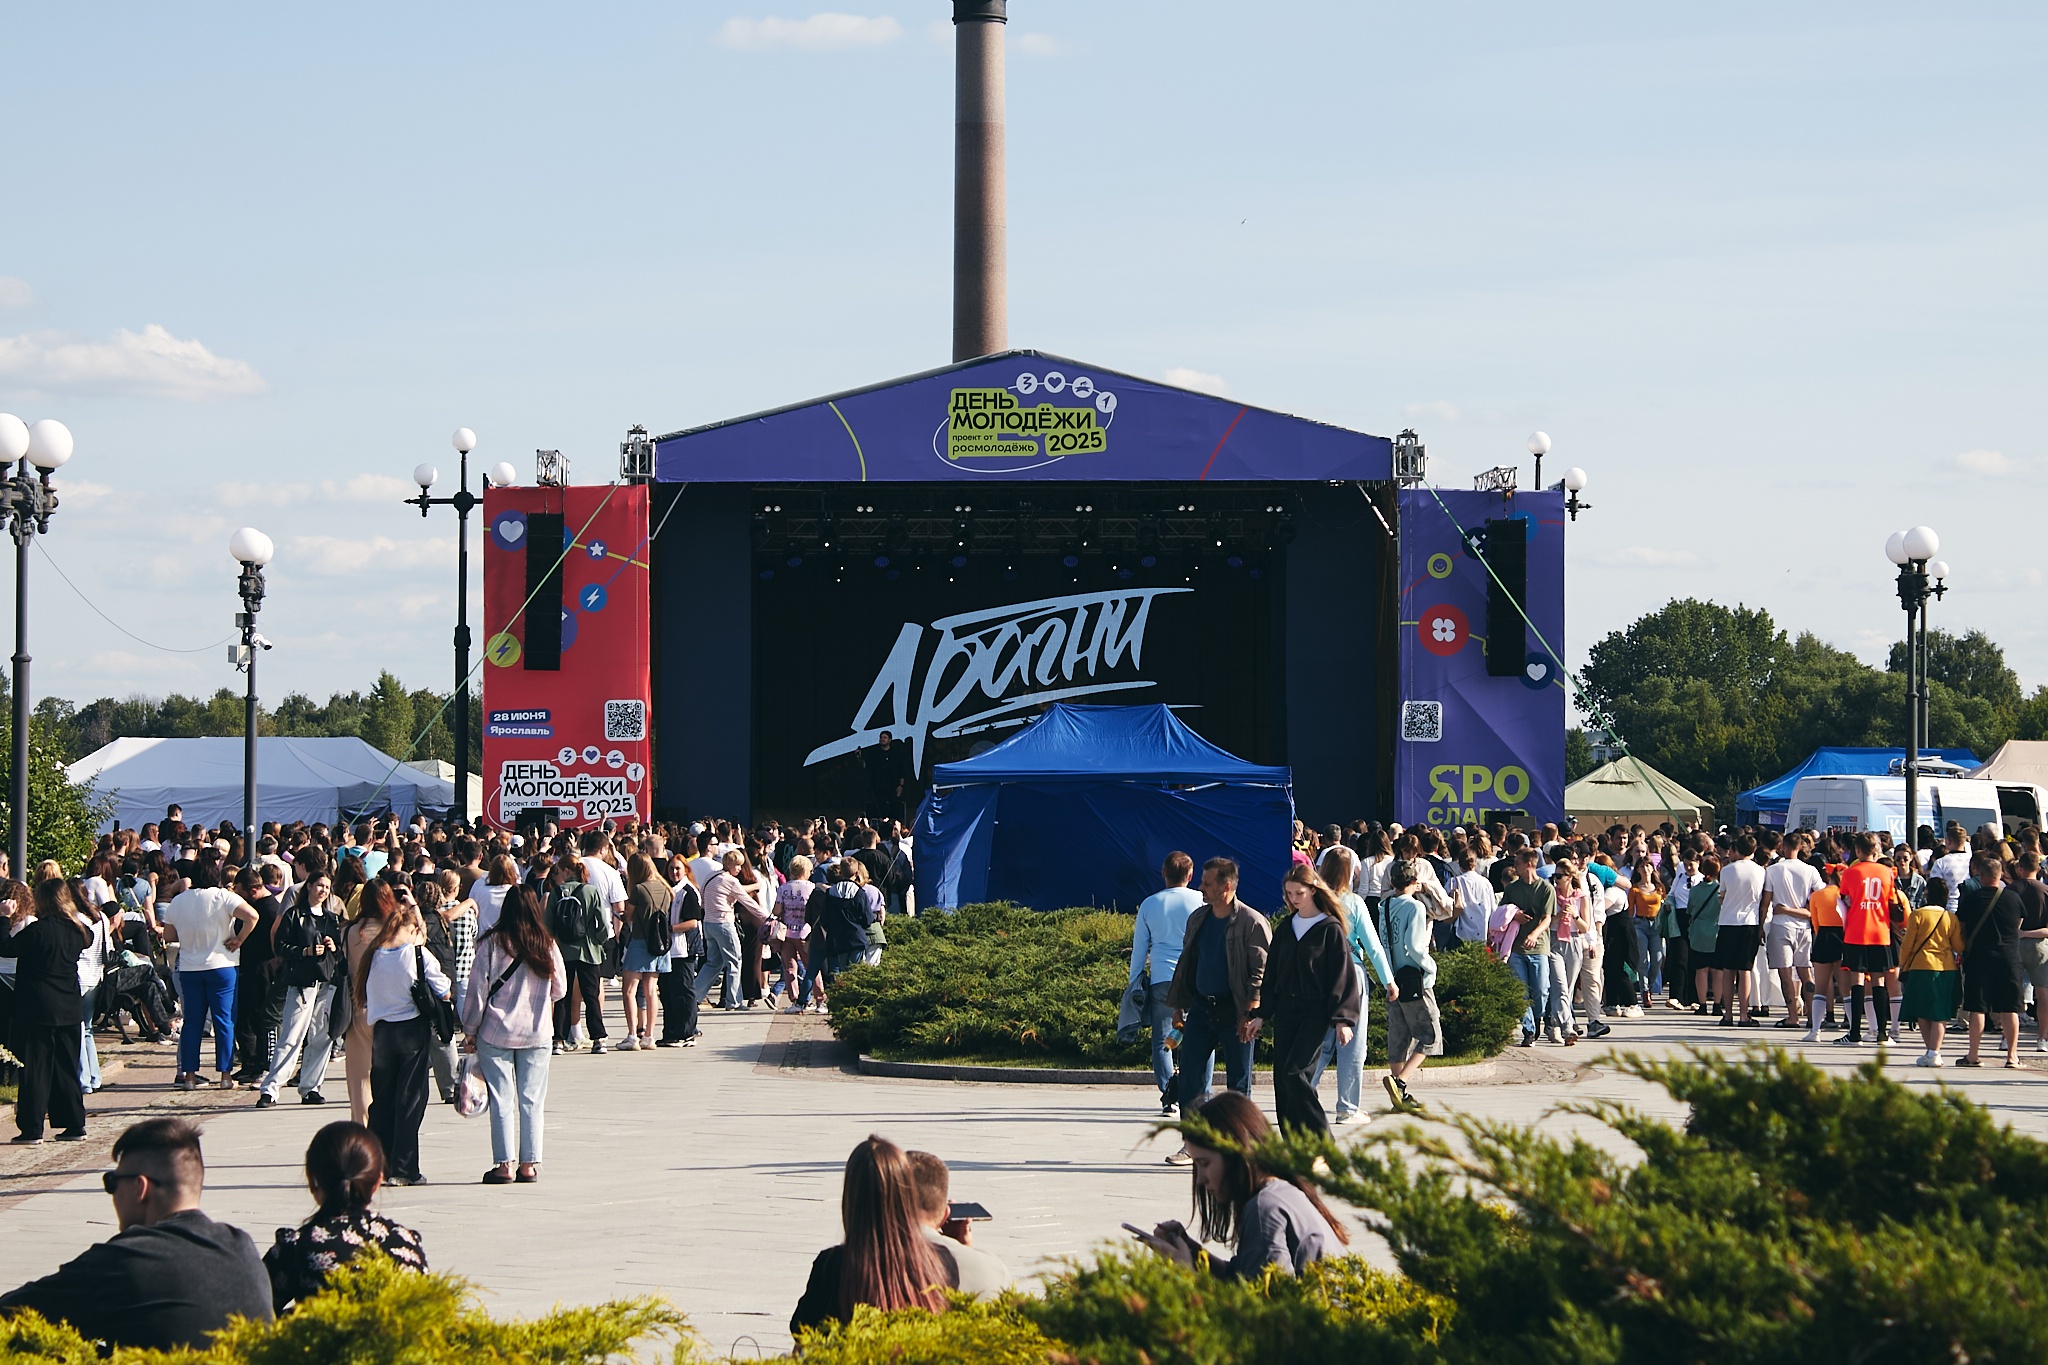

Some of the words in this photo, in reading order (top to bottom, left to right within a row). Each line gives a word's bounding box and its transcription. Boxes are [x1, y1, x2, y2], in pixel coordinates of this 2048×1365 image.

[952, 392, 1015, 412] ДЕНЬ
[952, 407, 1092, 432] МОЛОДЁЖИ
[952, 443, 1035, 456] росмолодёжь
[1049, 431, 1102, 452] 2025
[493, 713, 510, 722] 28
[510, 711, 547, 721] ИЮНЯ
[490, 725, 551, 736] Ярославль
[503, 765, 557, 782] ДЕНЬ
[503, 777, 624, 799] МОЛОДЁЖИ
[1428, 764, 1531, 805] ЯРО
[586, 797, 633, 816] 2025
[1862, 876, 1882, 901] 10
